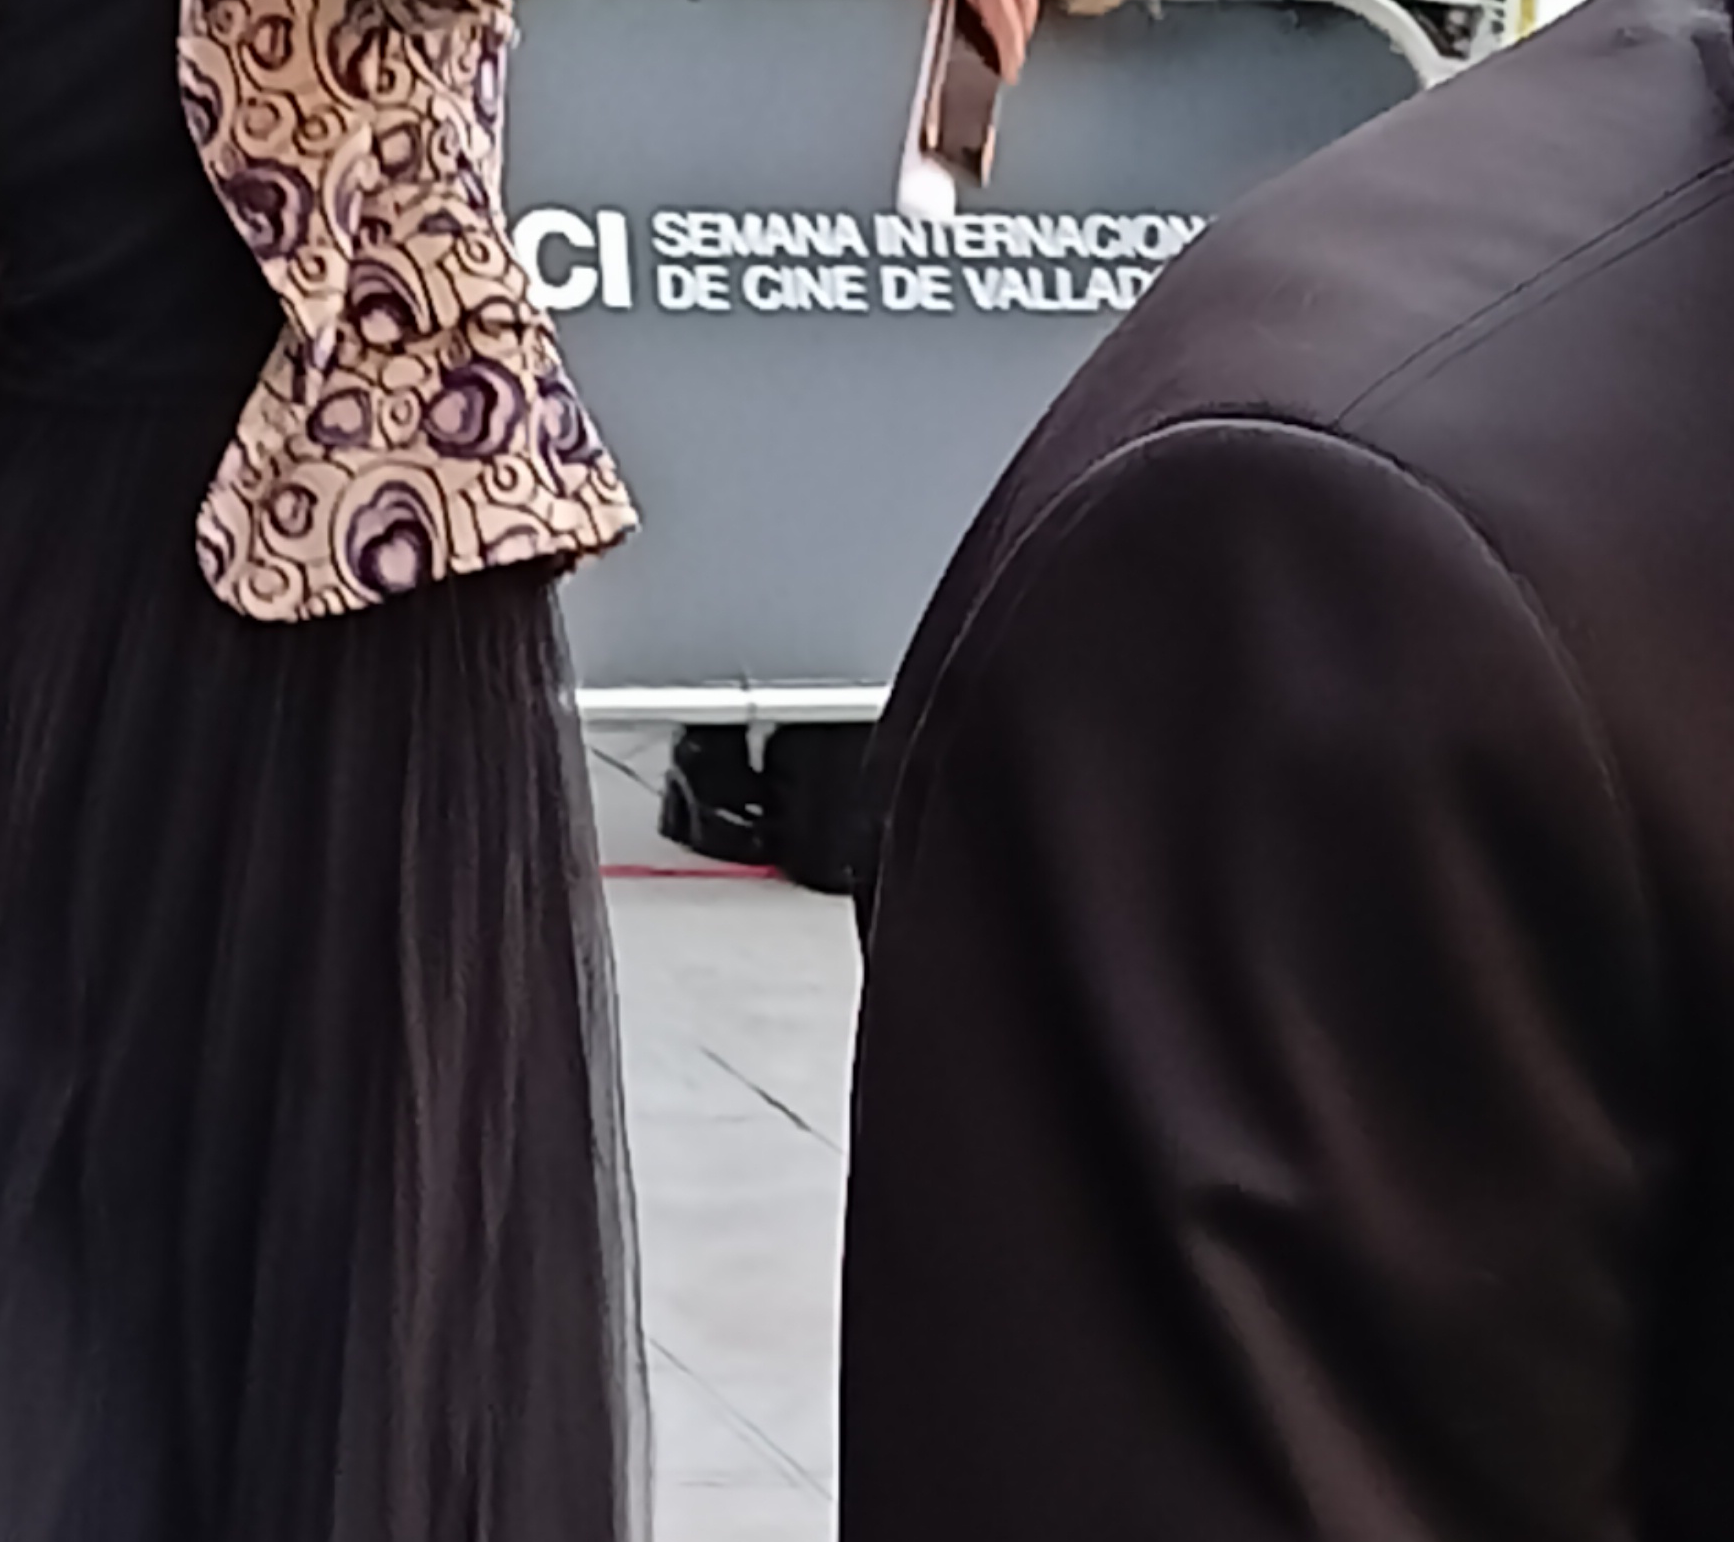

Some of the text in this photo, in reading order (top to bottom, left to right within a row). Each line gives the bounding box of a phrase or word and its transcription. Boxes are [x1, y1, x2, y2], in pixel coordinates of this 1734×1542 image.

[651, 211, 870, 258] SEMANA
[656, 264, 732, 311] DE
[742, 264, 870, 312] CINE
[880, 264, 956, 312] DE
